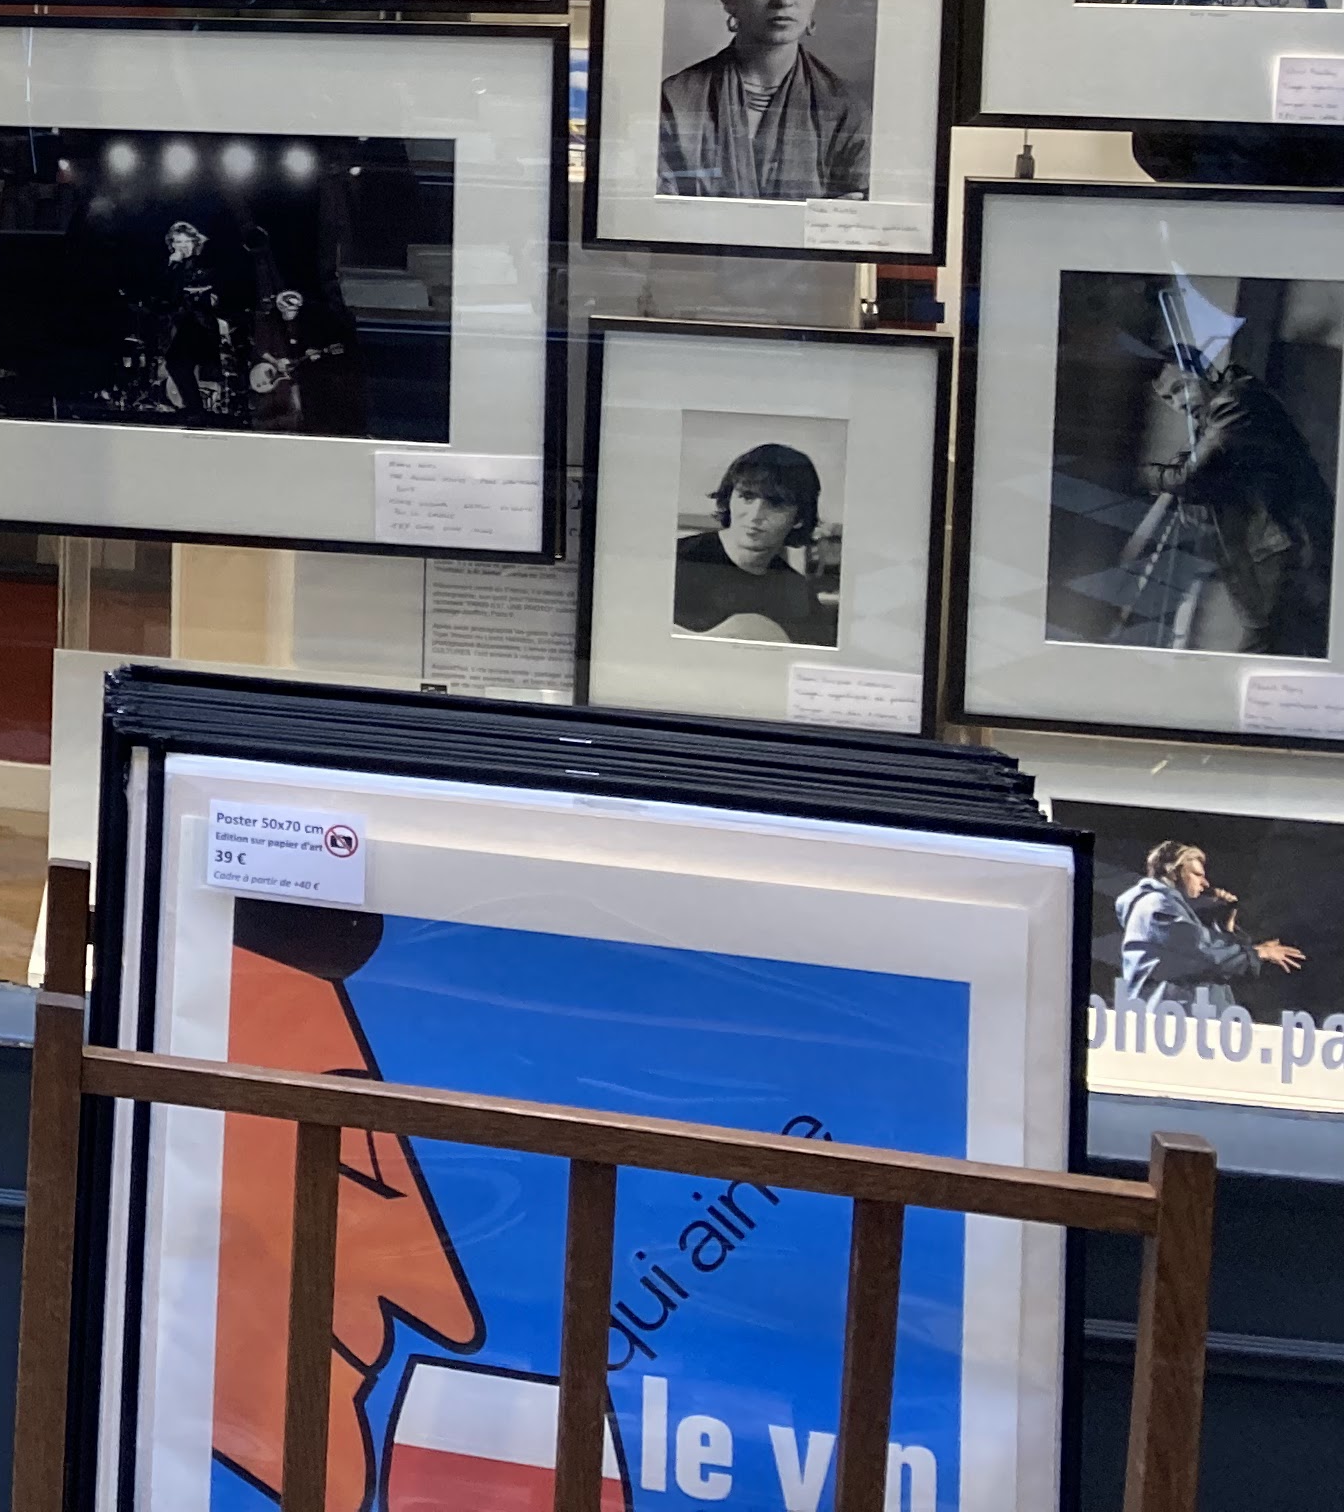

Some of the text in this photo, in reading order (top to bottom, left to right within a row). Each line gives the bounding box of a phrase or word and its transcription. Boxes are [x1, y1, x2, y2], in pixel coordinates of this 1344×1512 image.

[216, 812, 324, 835] Poster 50x70 cm
[215, 831, 249, 844] Edition
[250, 837, 265, 846] sur
[268, 838, 298, 850] papier
[214, 849, 247, 866] 39 €
[213, 870, 241, 882] Cadre
[242, 873, 249, 883] à
[250, 875, 278, 886] partir
[279, 878, 292, 888] de
[313, 882, 321, 891] €
[607, 1250, 691, 1372] qui
[640, 1374, 939, 1512] le vn
